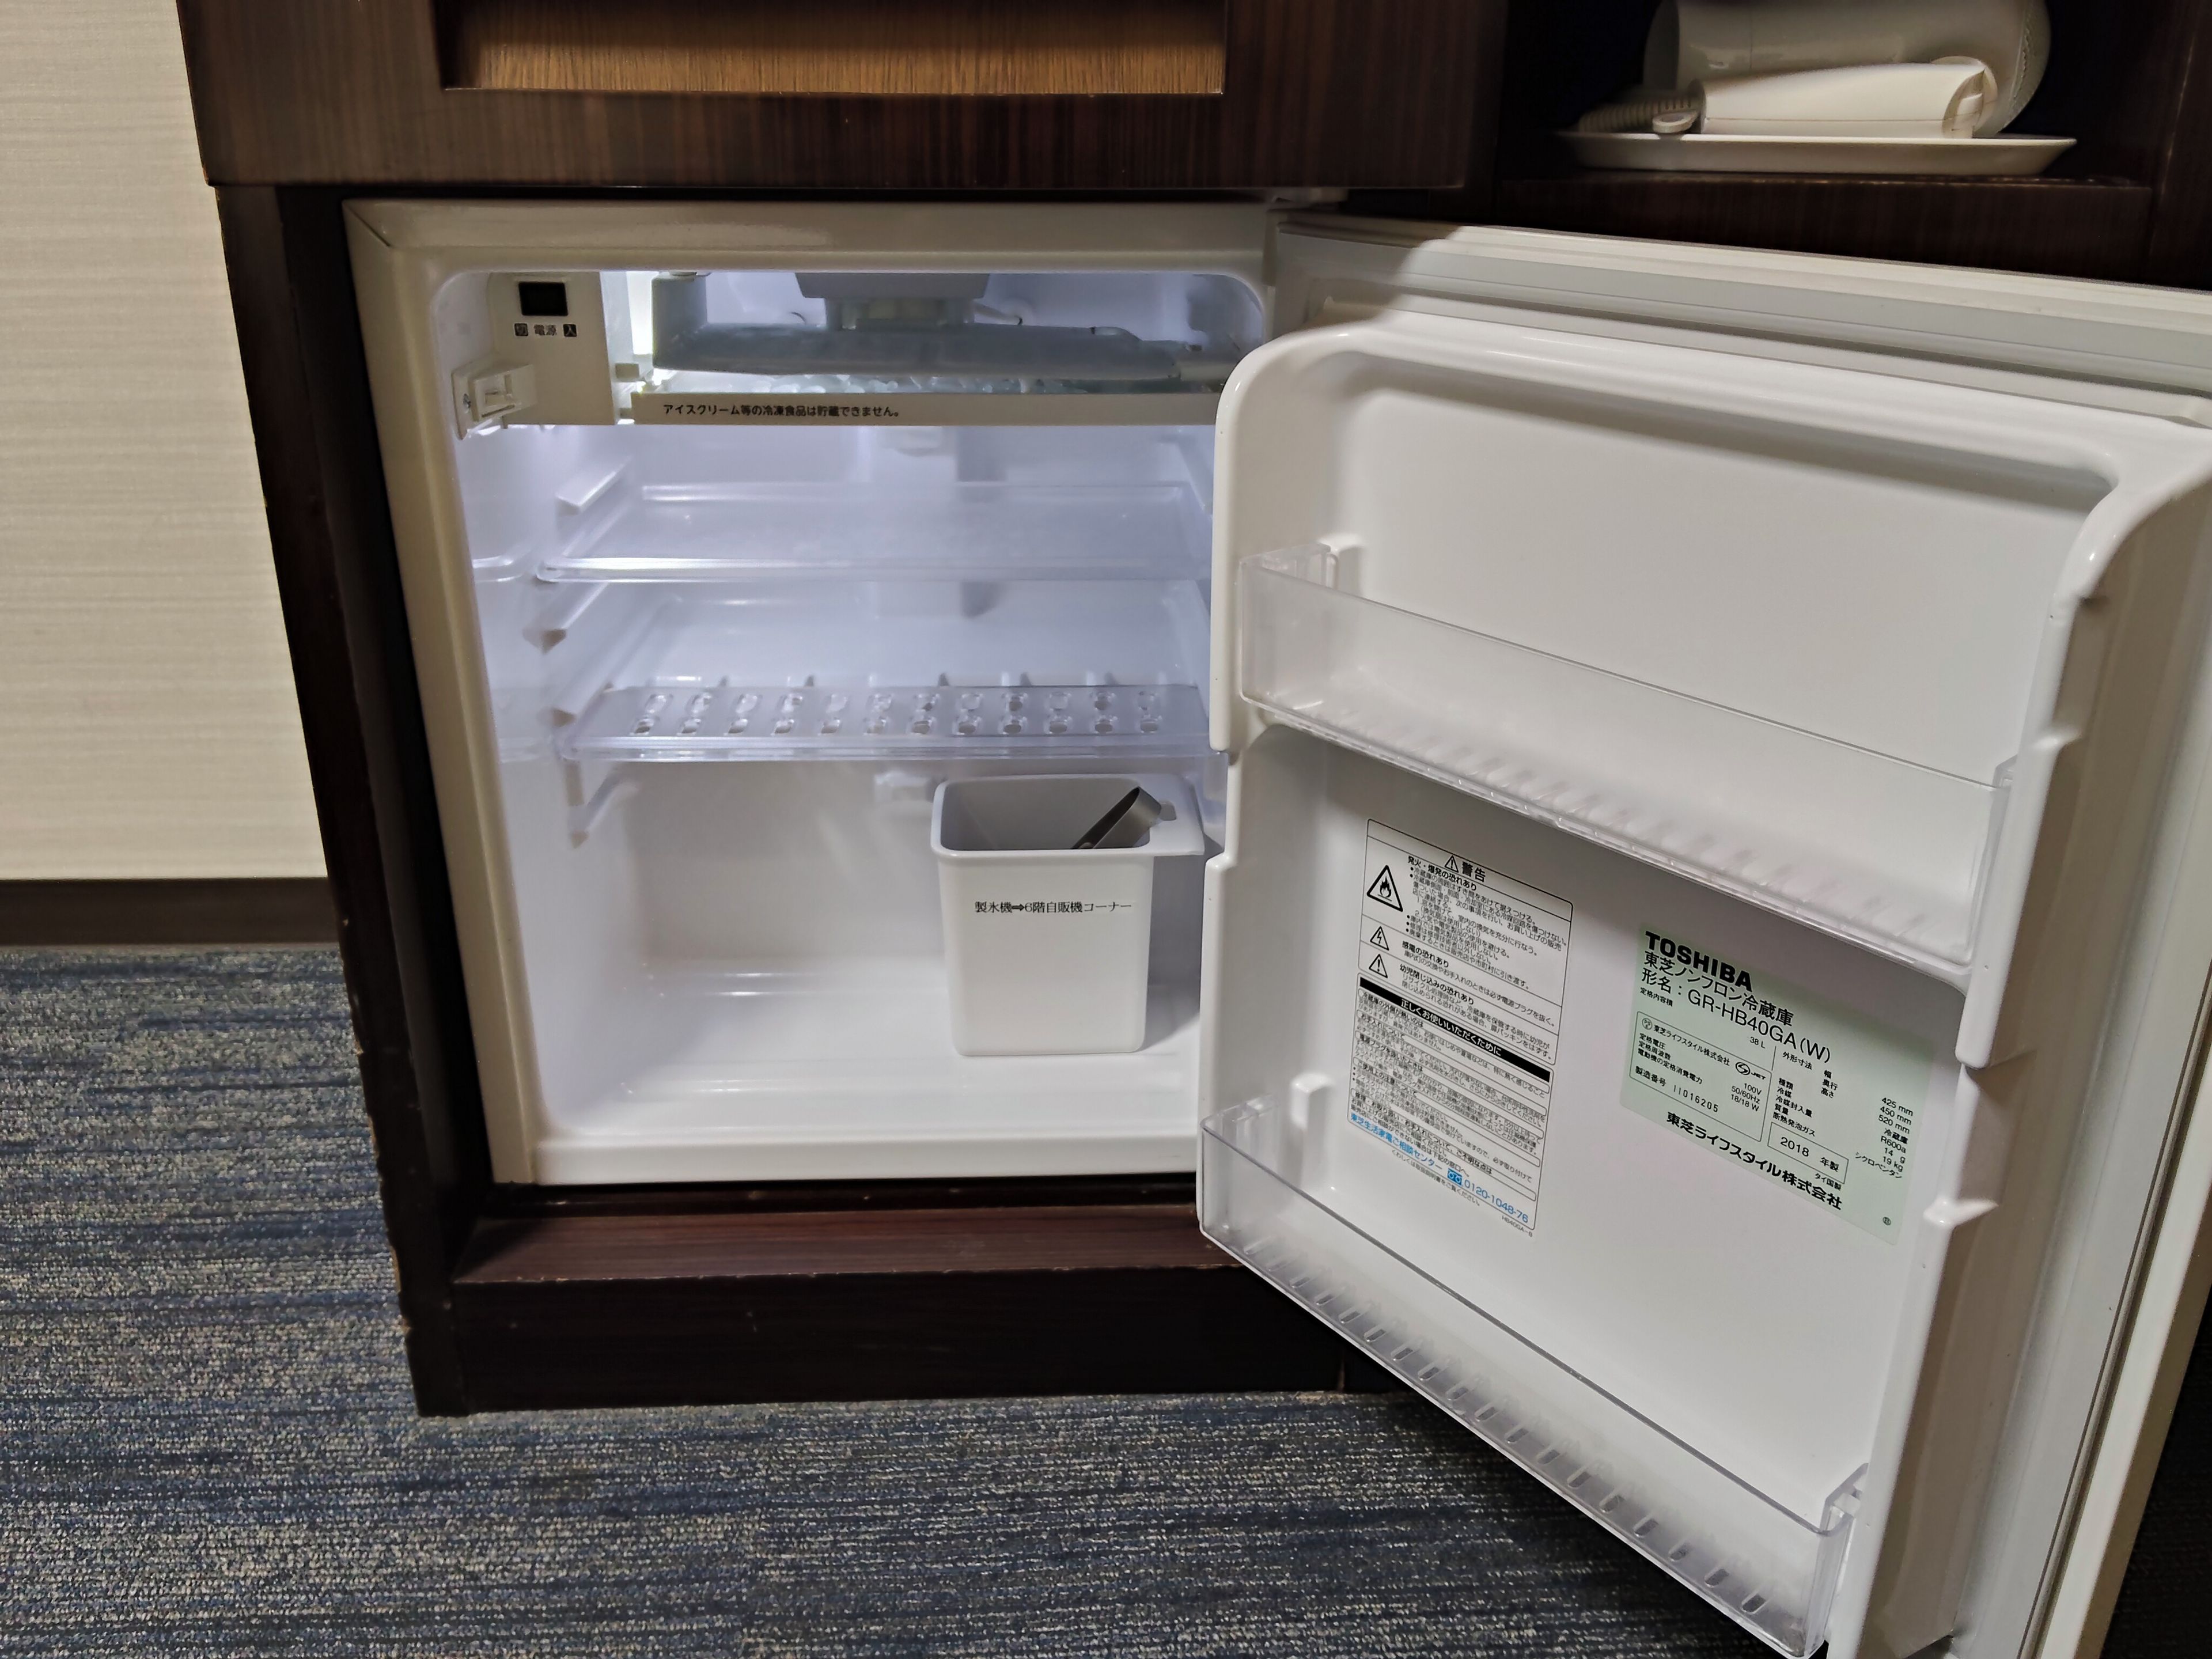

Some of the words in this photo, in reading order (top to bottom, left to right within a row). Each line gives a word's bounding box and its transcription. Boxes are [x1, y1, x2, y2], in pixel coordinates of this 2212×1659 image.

[664, 404, 899, 417] アイスクリーム等の冷凍食品は貯蔵できません。
[1408, 855, 1476, 892] 発火・爆発の恐れあり
[1461, 861, 1486, 882] 警告
[1402, 940, 1449, 968] 感電の恐れあり
[1644, 931, 1754, 992] TOSHIBA
[1400, 963, 1474, 1006] 幼児閉じ込みの恐れあり
[1643, 950, 1794, 1028] 東芝ノンフロン冷蔵庫
[1401, 998, 1501, 1056] 正しくお使いいただくために
[1640, 987, 1673, 1007] 定格内容積
[1749, 1036, 1759, 1046] 38
[1635, 1066, 1666, 1088] 製造番号
[1637, 1047, 1703, 1085] 電動機の定格消費電力
[1730, 1093, 1750, 1108] 18/18
[1751, 1103, 1759, 1112] W
[1638, 1040, 1671, 1061] 定格周波数
[1731, 1085, 1760, 1104] 50/60Hz
[1639, 1032, 1665, 1050] 定格電圧
[1743, 1082, 1762, 1096] 100V
[1653, 1024, 1730, 1067] 東芝ライフスタイル株式会社
[1751, 1070, 1766, 1081] JET
[1778, 1077, 1794, 1090] 種類
[1884, 1127, 1908, 1145] 冷蔵庫
[1782, 1051, 1812, 1070] 外形寸法
[1824, 1069, 1832, 1079] 幅
[1881, 1096, 1897, 1109] 425
[1898, 1105, 1913, 1117] mm
[1821, 1086, 1835, 1099] 高さ
[1878, 1114, 1893, 1127] 520
[1895, 1123, 1910, 1134] mm
[1822, 1078, 1838, 1092] 奥行
[1880, 1105, 1895, 1118] 450
[1896, 1114, 1911, 1126] mm
[1772, 1111, 1816, 1137] 断熱発泡ガス
[1774, 1103, 1789, 1116] 質量
[1882, 1155, 1893, 1166] 19
[1893, 1161, 1904, 1173] kg
[1775, 1094, 1812, 1118] 冷媒封入量
[1884, 1147, 1894, 1157] 14
[1777, 1086, 1792, 1099] 冷媒
[1880, 1135, 1906, 1153] R600a
[1350, 1112, 1442, 1172] 東芝生活家電ご相談センター
[1464, 1178, 1528, 1224] 0120-1048-76
[1666, 1111, 1842, 1210] 東芝ライフスタイル株式会社
[1780, 1136, 1809, 1158] 2018
[1820, 1156, 1839, 1173] 年製
[1814, 1172, 1841, 1191] タイ国製
